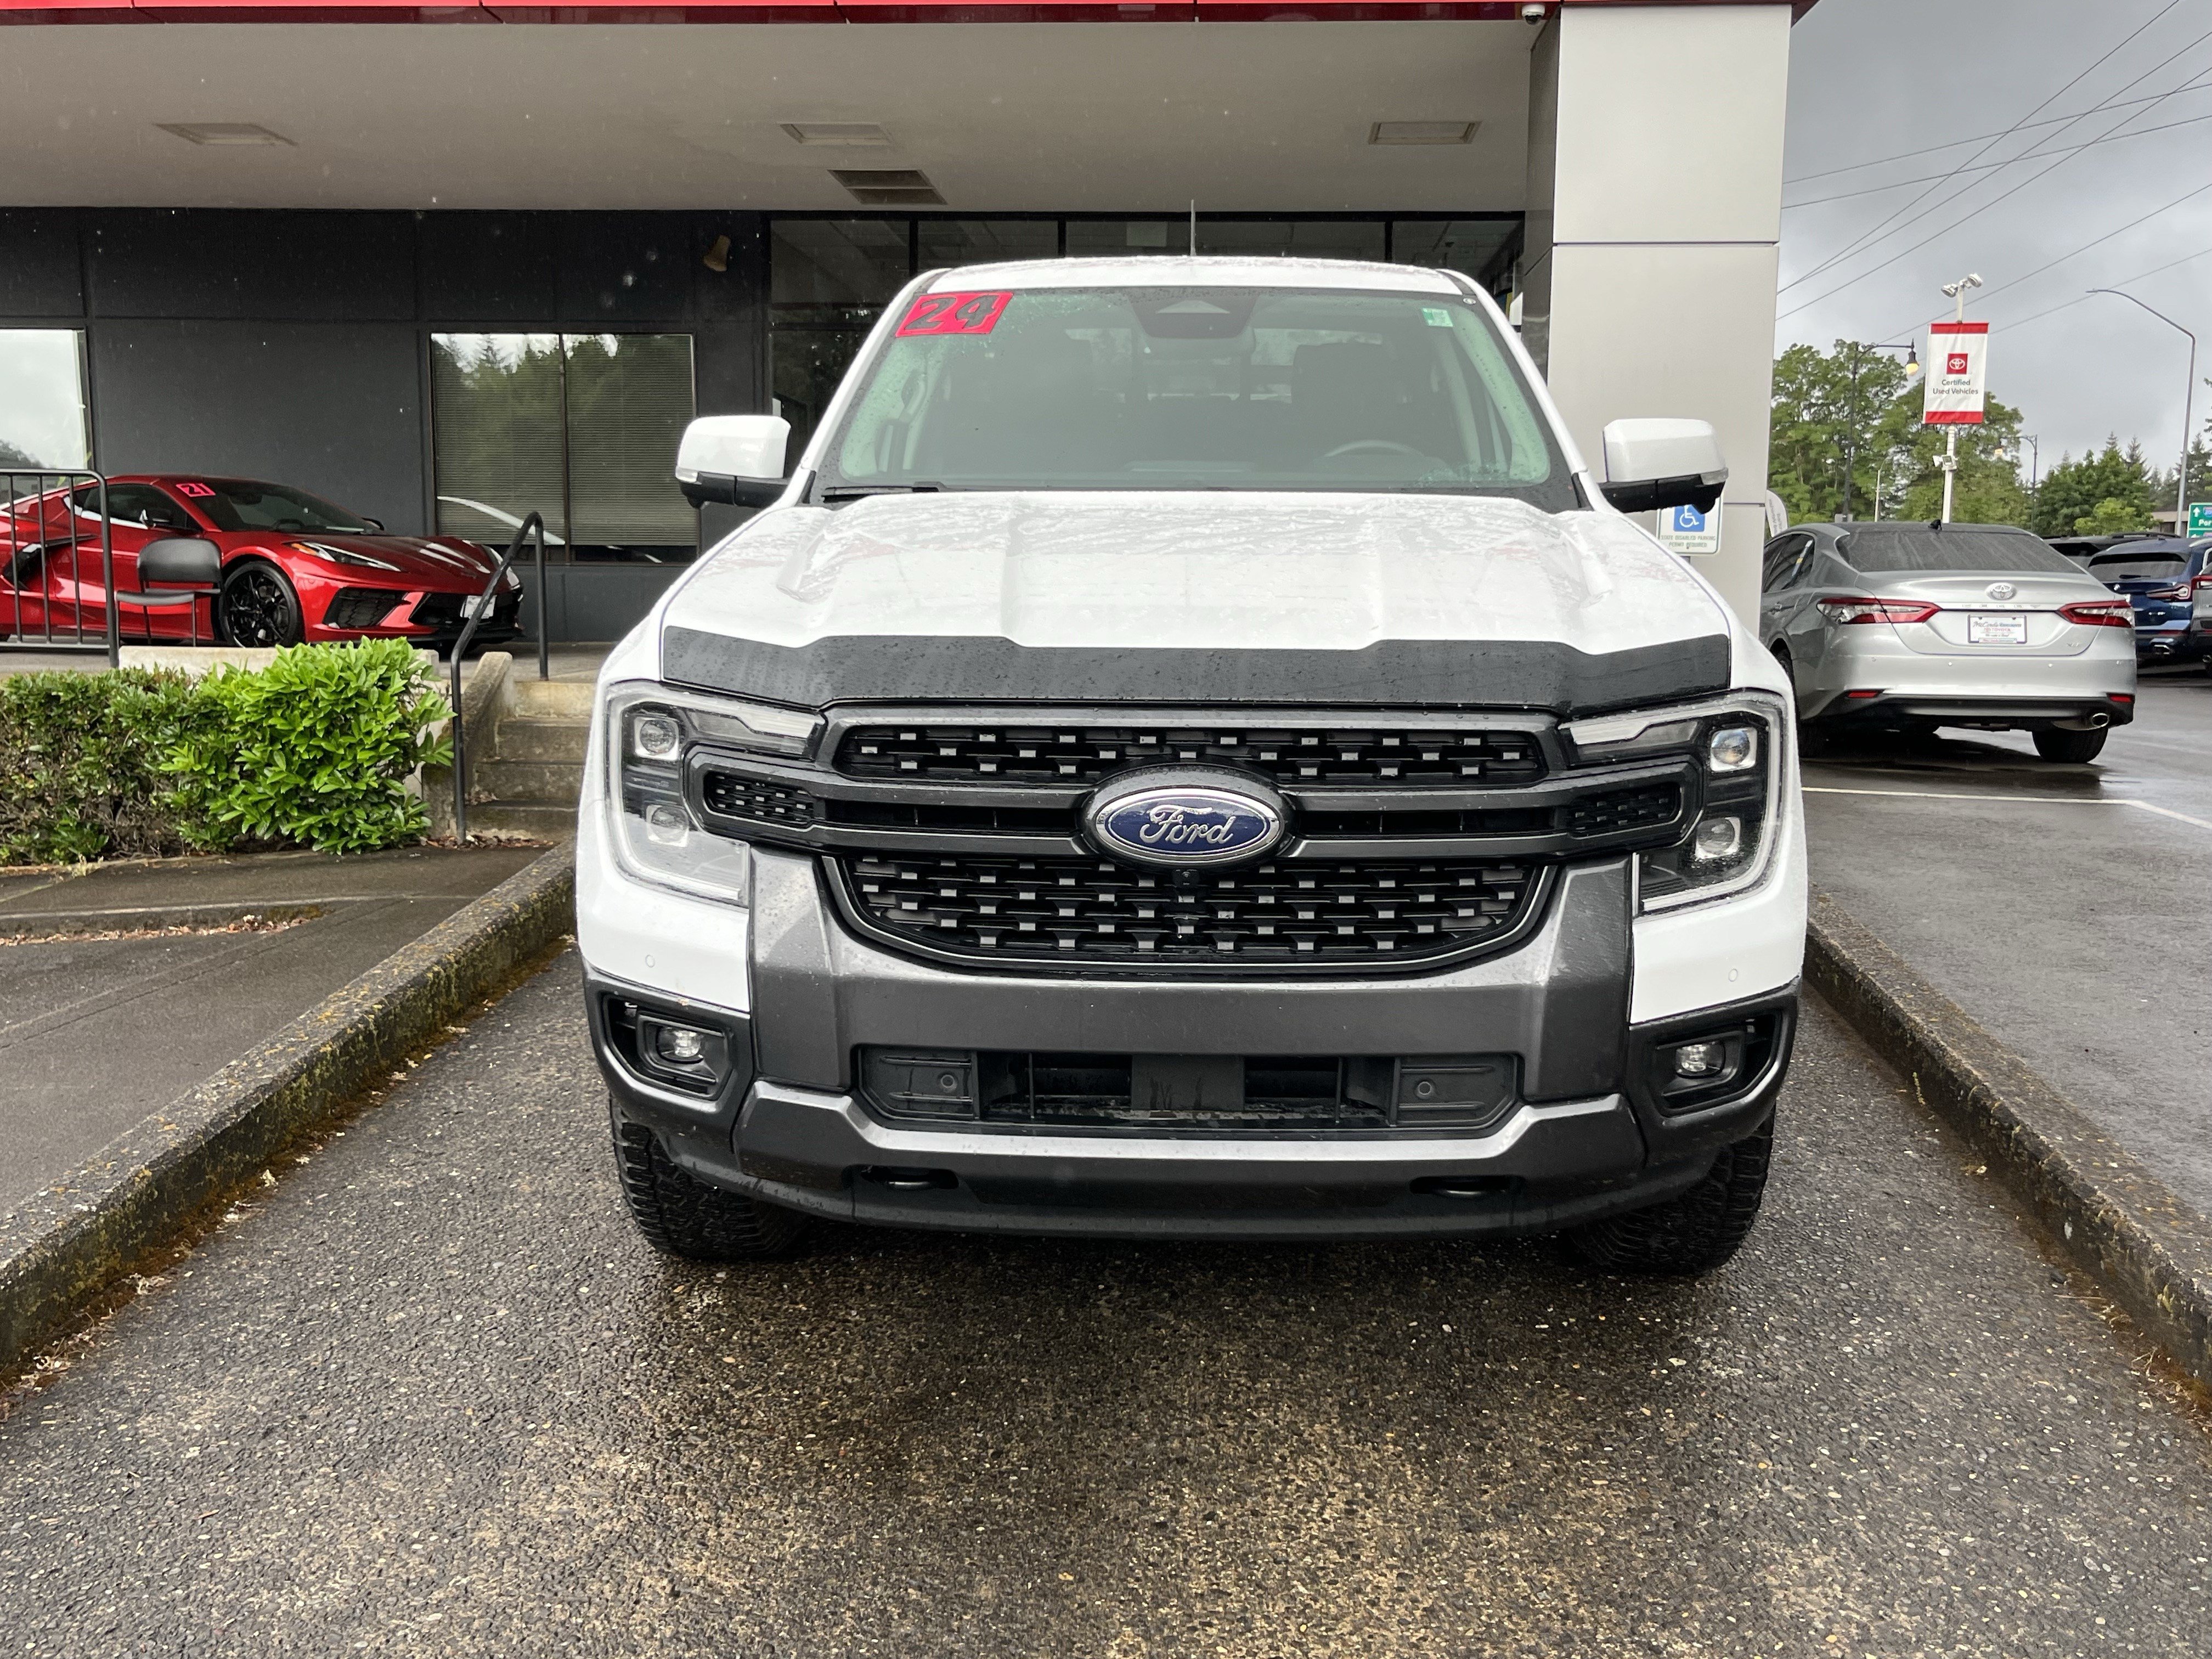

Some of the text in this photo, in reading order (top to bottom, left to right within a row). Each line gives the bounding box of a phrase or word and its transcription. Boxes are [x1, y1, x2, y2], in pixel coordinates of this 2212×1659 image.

[904, 295, 1000, 330] 24
[181, 483, 210, 495] 21
[1139, 804, 1236, 844] Ford
